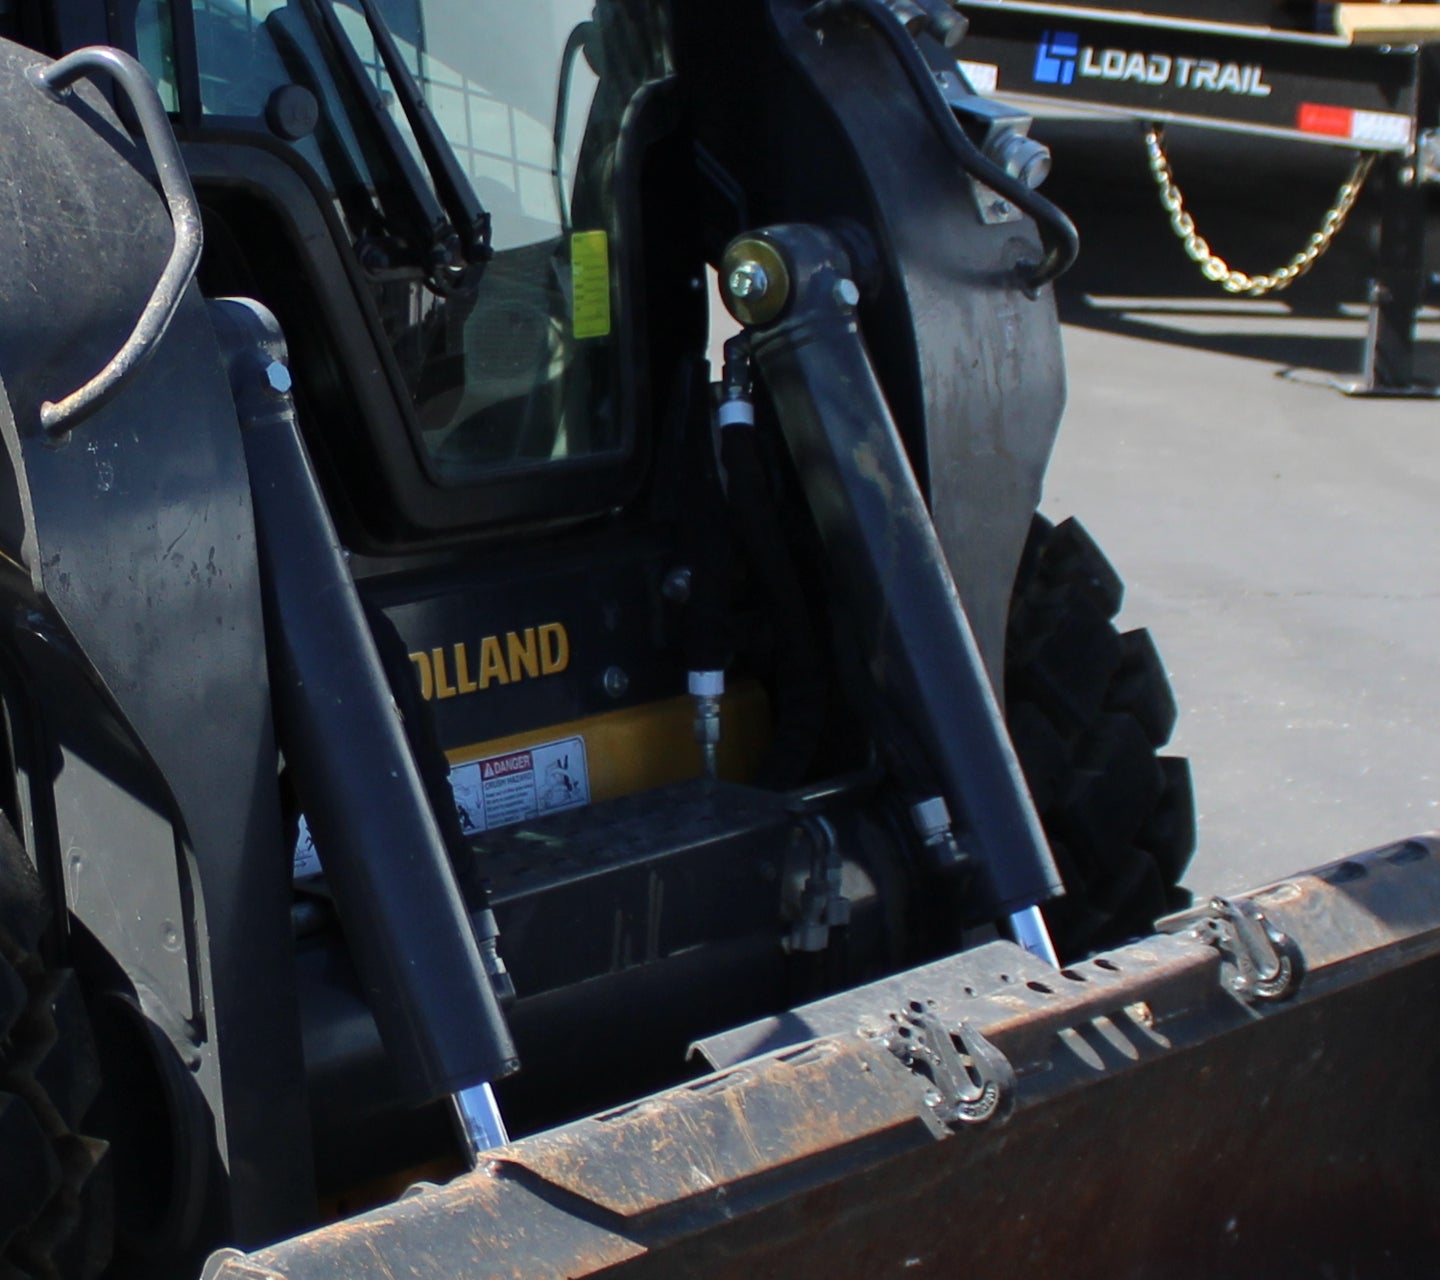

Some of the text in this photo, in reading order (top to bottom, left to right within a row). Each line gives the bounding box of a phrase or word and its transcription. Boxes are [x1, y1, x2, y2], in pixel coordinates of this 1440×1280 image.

[1080, 45, 1271, 97] LOAD TRAIL
[408, 622, 570, 701] OLLAND
[493, 754, 531, 775] DANGER
